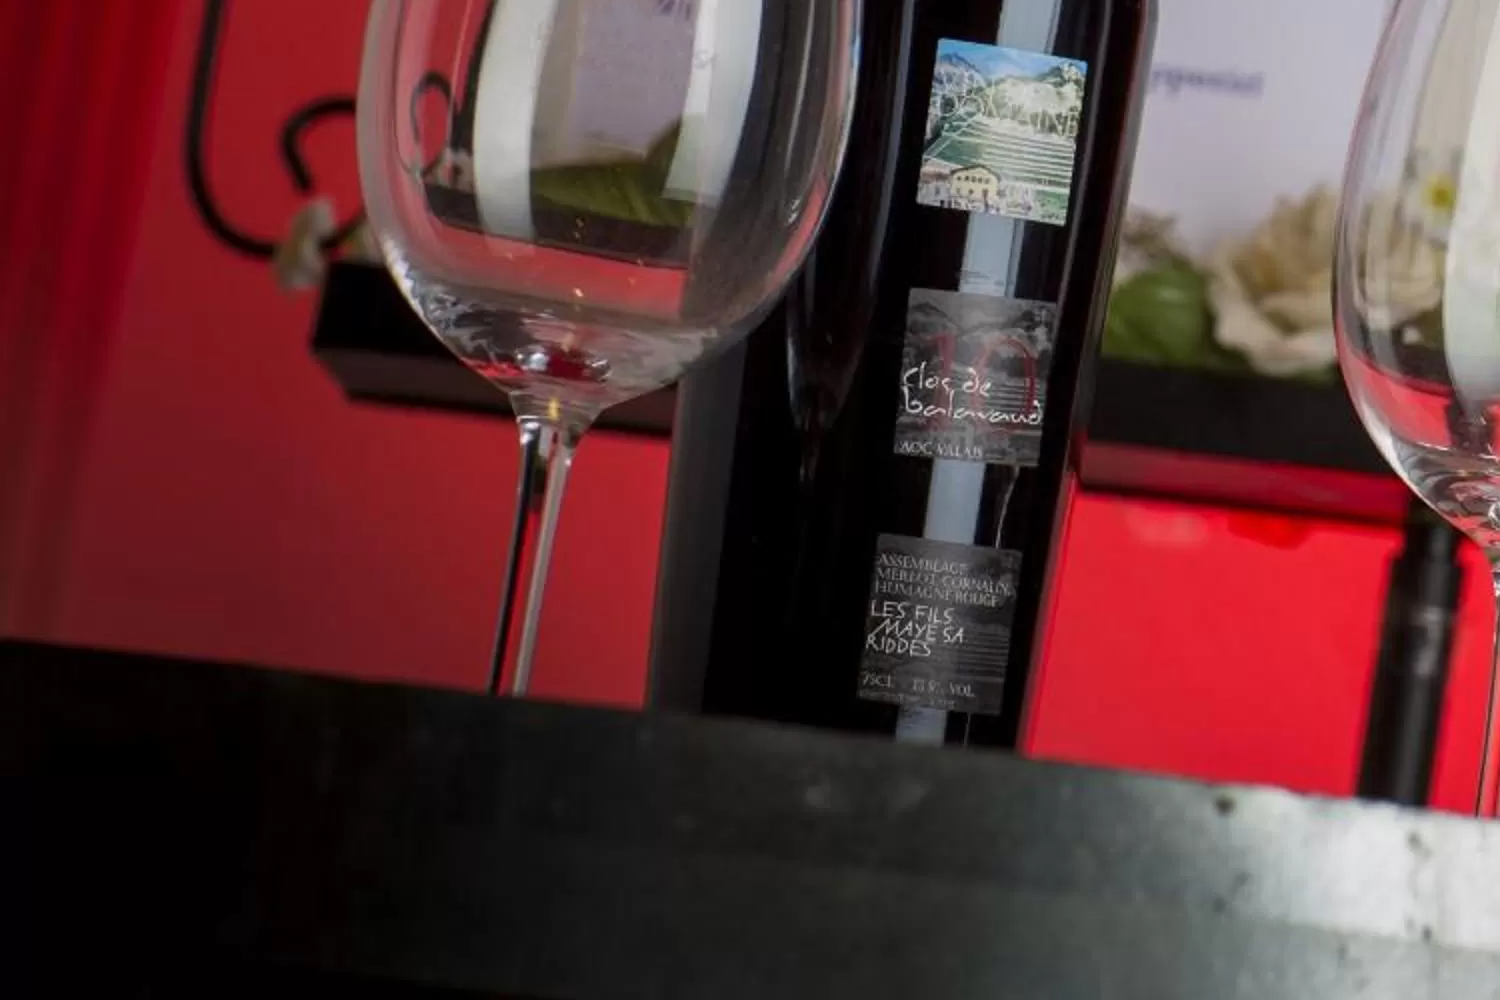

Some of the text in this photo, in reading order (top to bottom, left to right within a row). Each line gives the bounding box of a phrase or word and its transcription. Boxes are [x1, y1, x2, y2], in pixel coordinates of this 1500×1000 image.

[870, 600, 955, 625] LES FILS
[869, 618, 965, 643] MAYE SA
[865, 634, 931, 657] RIDDES
